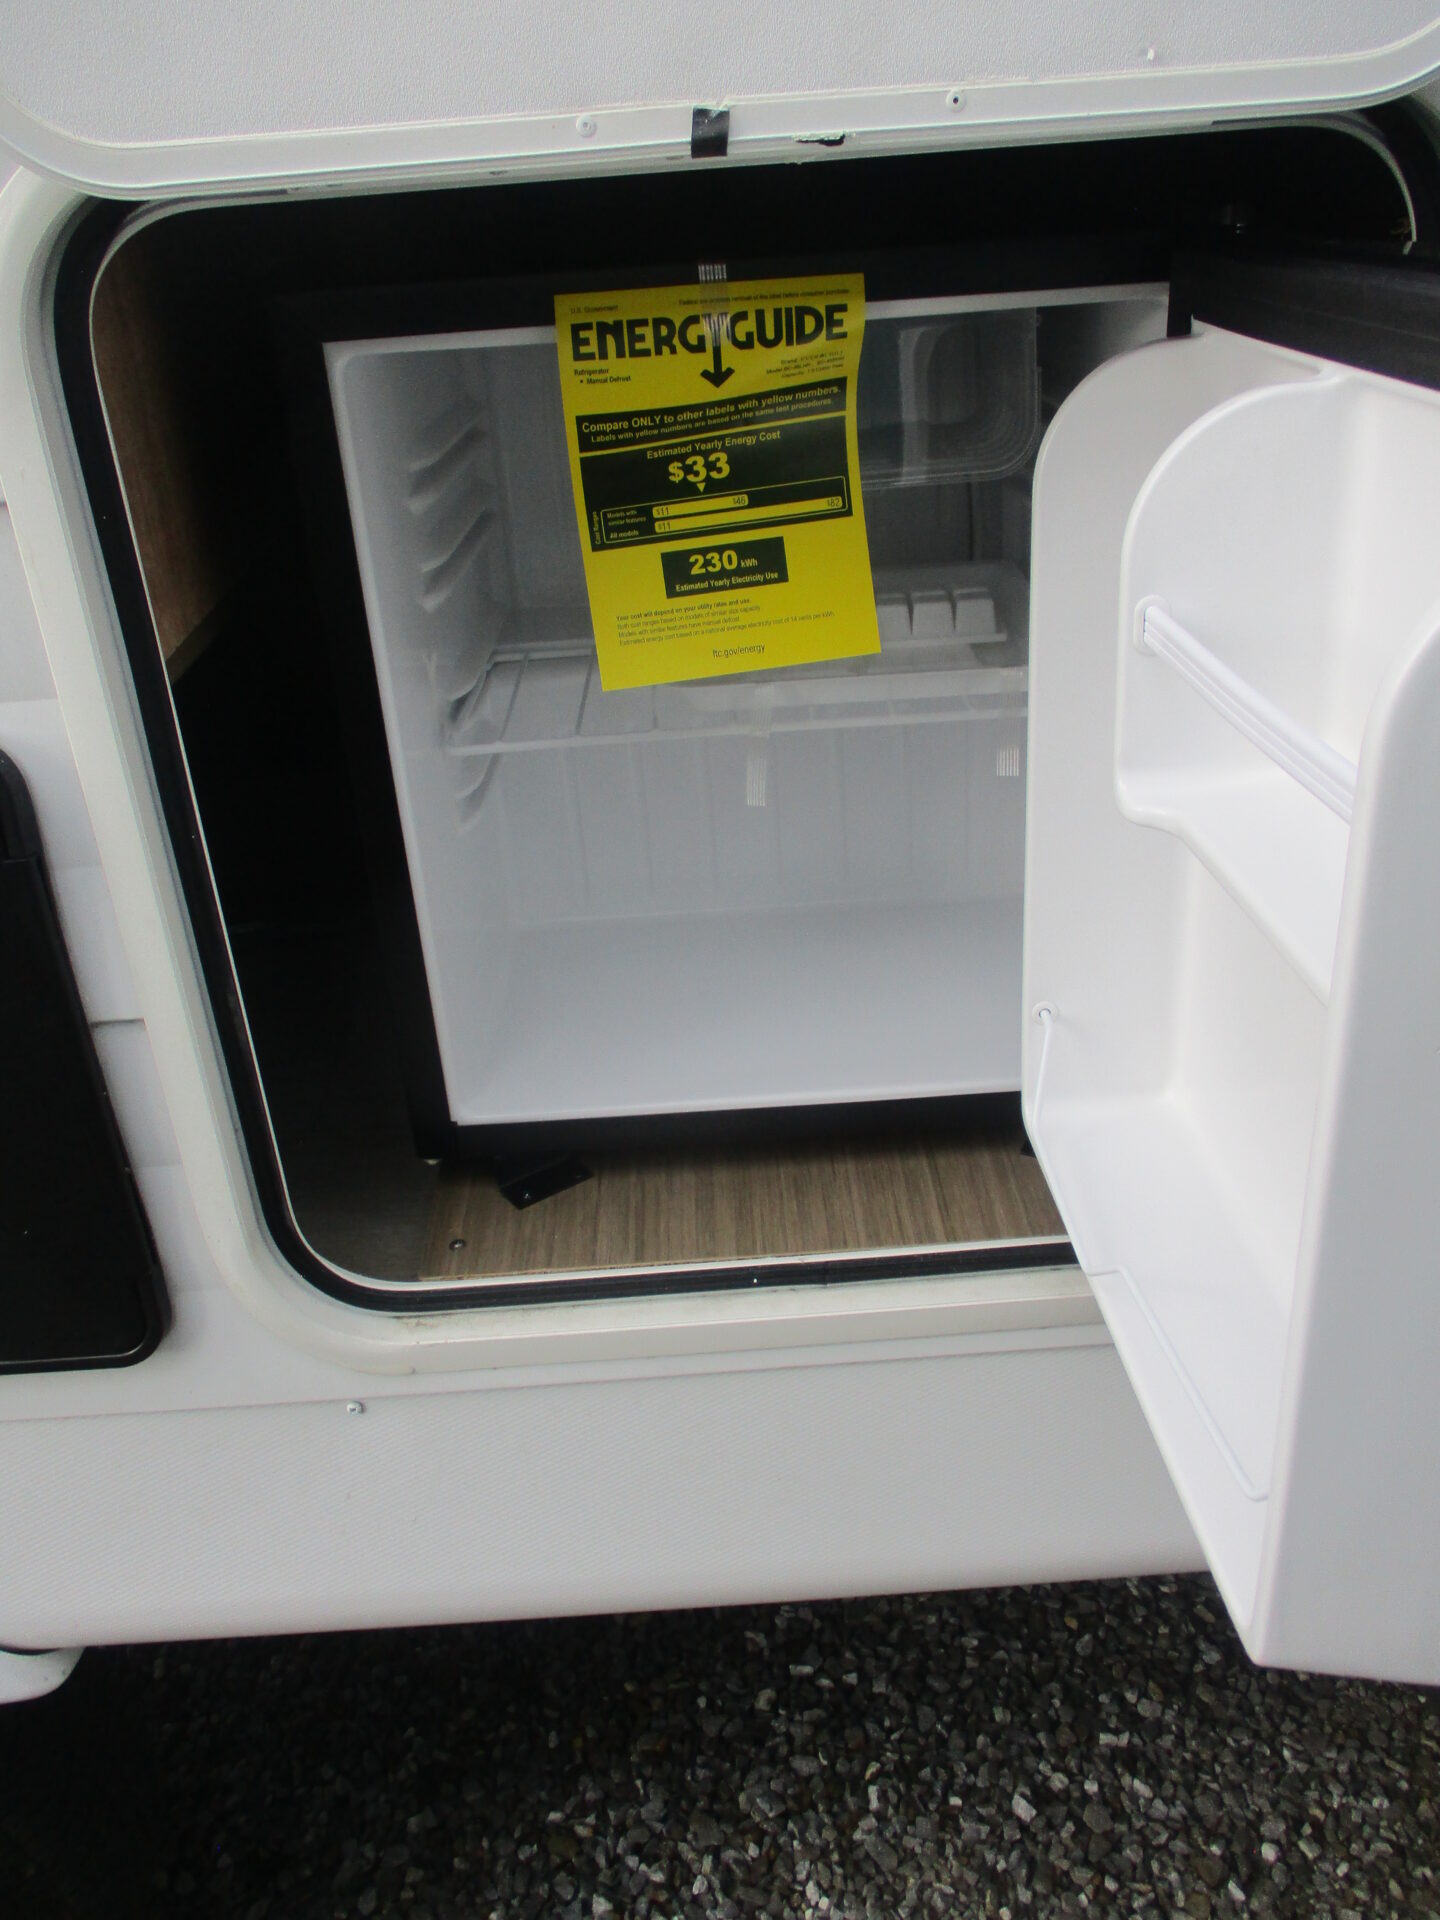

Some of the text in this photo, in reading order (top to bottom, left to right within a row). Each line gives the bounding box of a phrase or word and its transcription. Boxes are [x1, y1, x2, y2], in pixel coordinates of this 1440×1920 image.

[574, 368, 608, 376] Refrigerator
[582, 386, 841, 433] Compare ONLY to other labels with yellow numbers.
[591, 433, 616, 443] Labels
[618, 431, 634, 439] with
[635, 428, 659, 440] yellow
[661, 423, 693, 434] numbers
[708, 414, 730, 425] based
[742, 410, 754, 419] the
[755, 408, 774, 417] same
[776, 404, 790, 412] test
[647, 430, 780, 459] Estimated Yearly Energy Cost
[668, 452, 730, 483] $33
[610, 529, 639, 539] All models
[689, 550, 758, 575] 230 kWh
[675, 571, 778, 592] Estimated Yearly Electricity Use
[654, 608, 675, 617] depend
